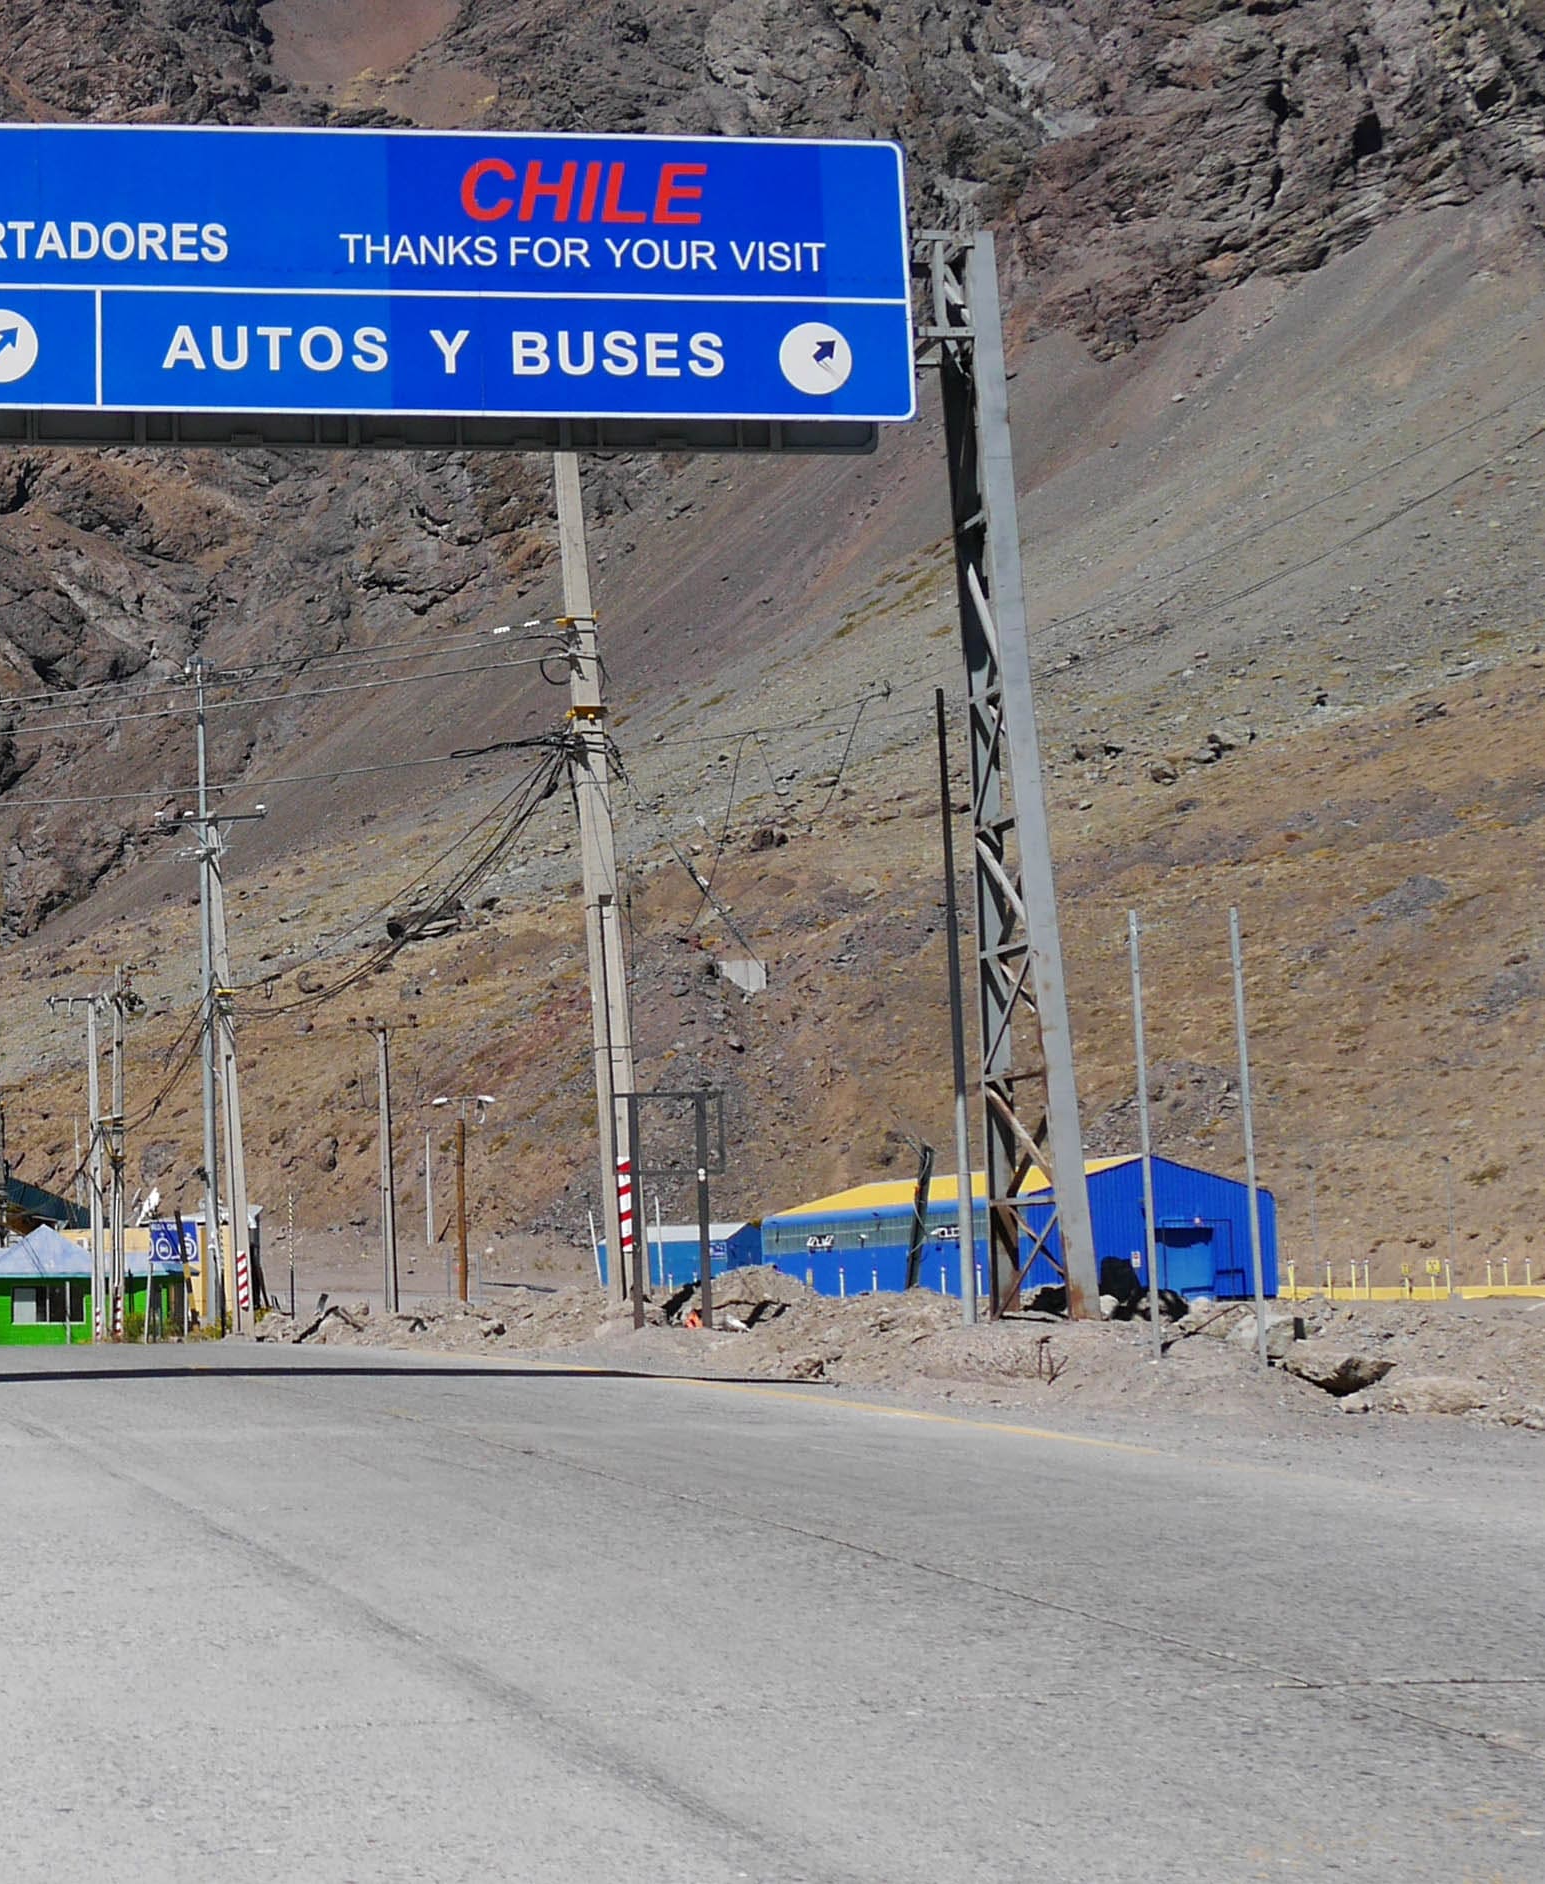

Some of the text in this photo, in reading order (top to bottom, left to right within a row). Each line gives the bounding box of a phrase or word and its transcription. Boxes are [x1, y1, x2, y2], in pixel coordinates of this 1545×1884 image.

[460, 158, 708, 224] CHILE
[338, 233, 827, 272] THANKS FOR YOUR VISIT
[161, 325, 726, 377] AUTOS Y BUSES
